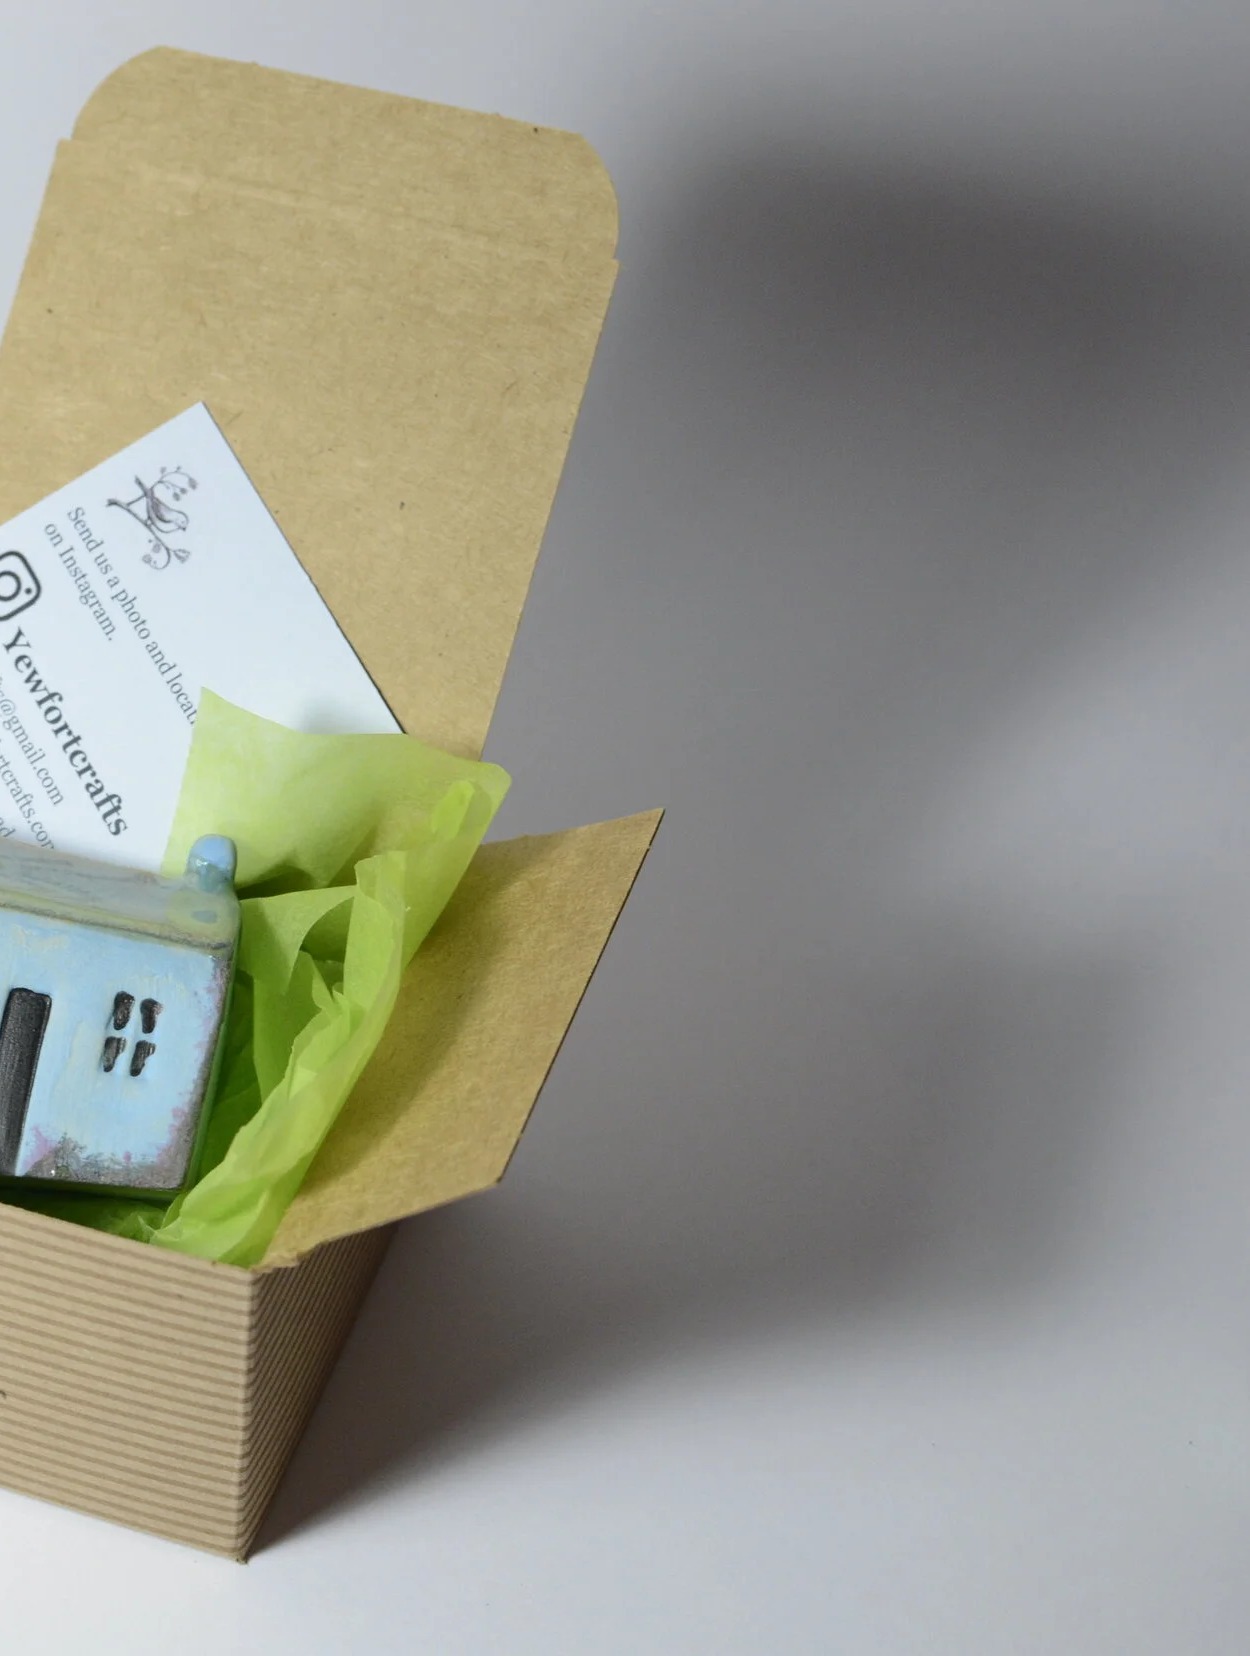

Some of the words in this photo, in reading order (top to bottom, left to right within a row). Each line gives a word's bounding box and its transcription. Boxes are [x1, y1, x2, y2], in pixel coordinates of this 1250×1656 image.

[66, 506, 104, 553] Send
[44, 523, 64, 548] on
[58, 545, 116, 642] Instagram.
[93, 552, 113, 577] us
[106, 575, 121, 590] a
[111, 588, 151, 640] photo
[144, 640, 178, 676] and
[2, 625, 129, 837] Yewfortcrafts
